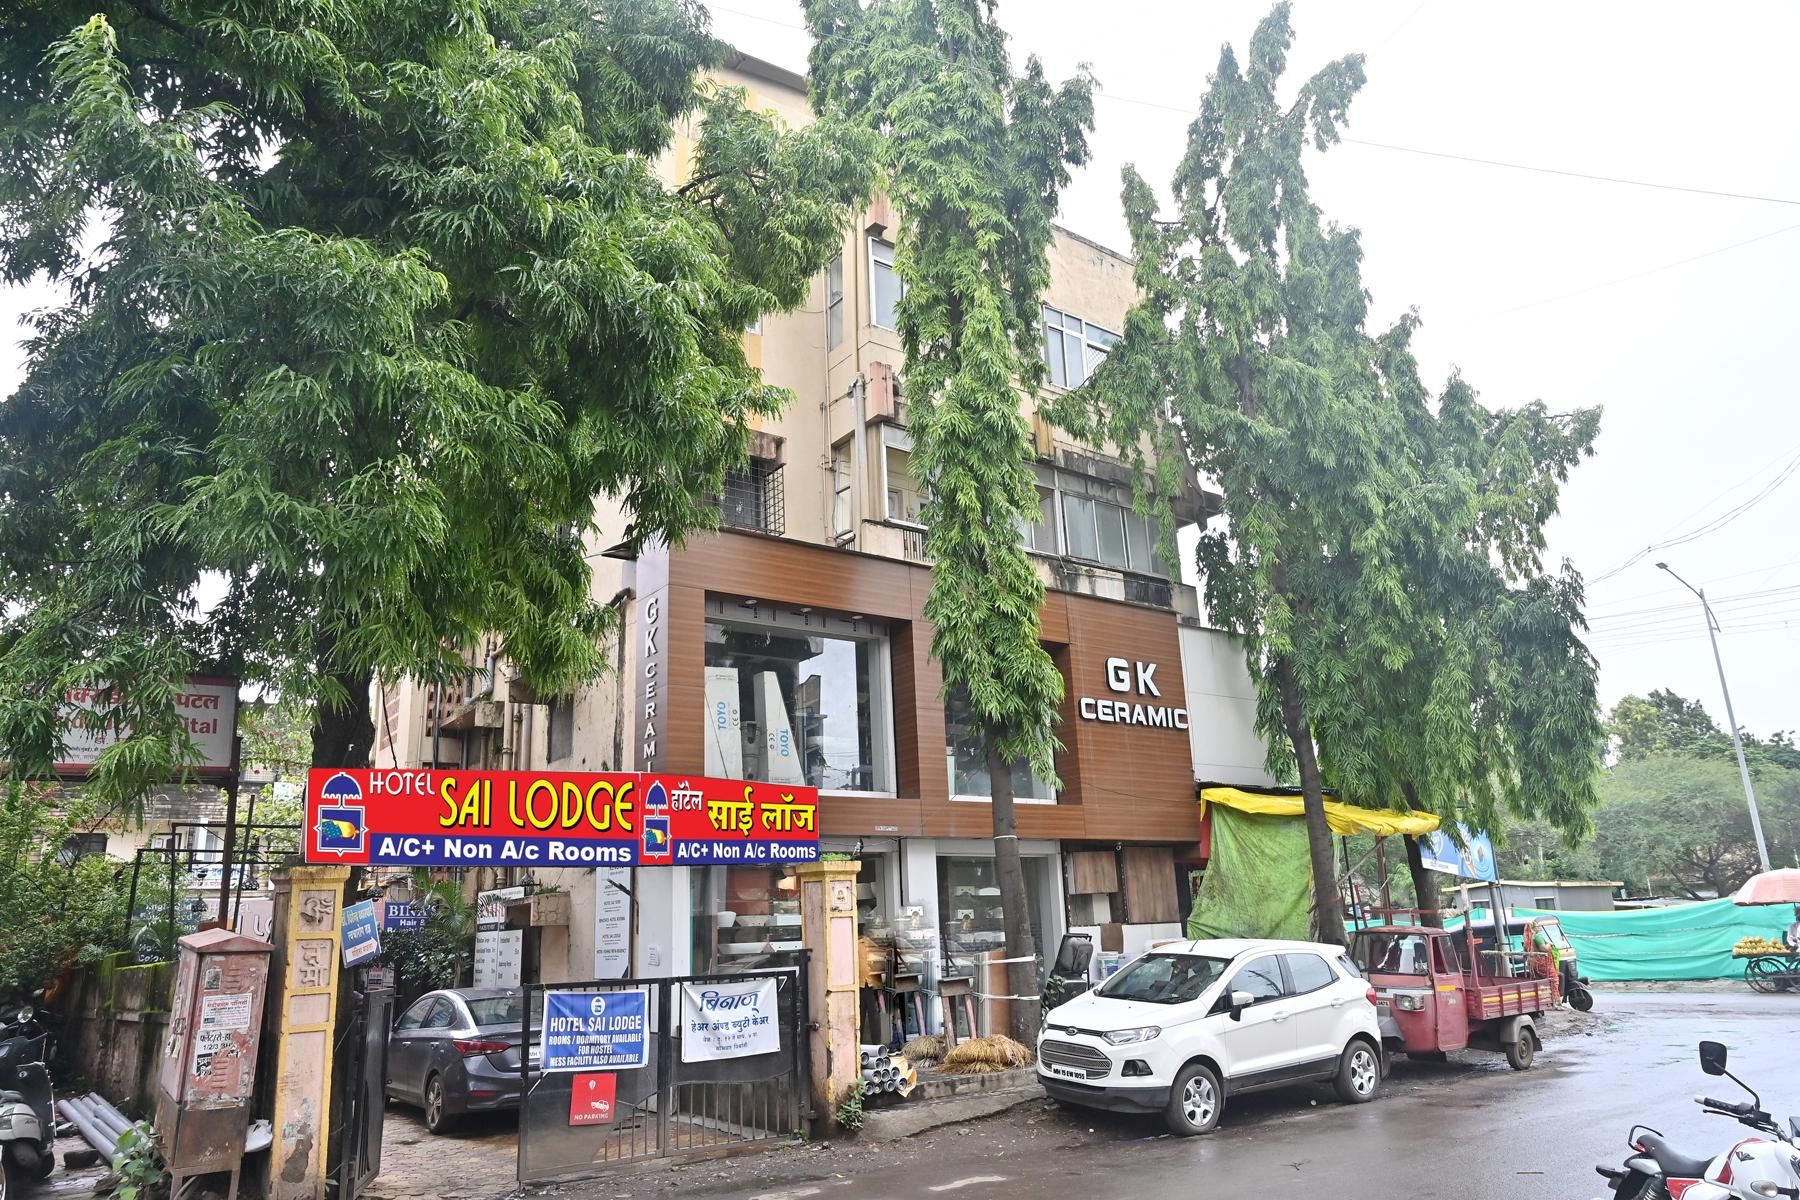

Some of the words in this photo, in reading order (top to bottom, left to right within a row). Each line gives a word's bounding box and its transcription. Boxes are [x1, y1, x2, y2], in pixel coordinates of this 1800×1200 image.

[1104, 656, 1161, 697] GK
[643, 662, 657, 773] CERAMI
[717, 701, 727, 730] TOYO
[1079, 697, 1188, 729] CERAMIC
[780, 728, 789, 757] TOYO
[369, 771, 436, 796] HOTEL
[439, 776, 493, 829] SAI
[508, 778, 634, 832] LODGE
[707, 785, 755, 837] साई
[760, 793, 816, 831] लॉज
[378, 837, 435, 857] A/C+
[444, 838, 493, 859] Non
[500, 840, 540, 860] A/c
[548, 841, 632, 862] Rooms
[677, 842, 709, 859] A/C+
[713, 842, 740, 859] Non
[744, 842, 766, 859] A/c
[770, 842, 817, 859] Rooms
[550, 1017, 585, 1032] HOTEL
[588, 1017, 606, 1032] SAI
[609, 1015, 642, 1031] LODGE
[548, 1036, 571, 1046] ROOMS
[576, 1034, 612, 1045] DORMITORY
[612, 1033, 642, 1043] AVAILABLE
[578, 1046, 591, 1055] FOR
[591, 1045, 613, 1054] HOSTEL
[550, 1057, 567, 1067] MESS
[567, 1055, 592, 1065] FACILITY
[592, 1055, 608, 1065] ALSO
[608, 1053, 639, 1064] AVAILABLE
[583, 1112, 609, 1120] PARKING
